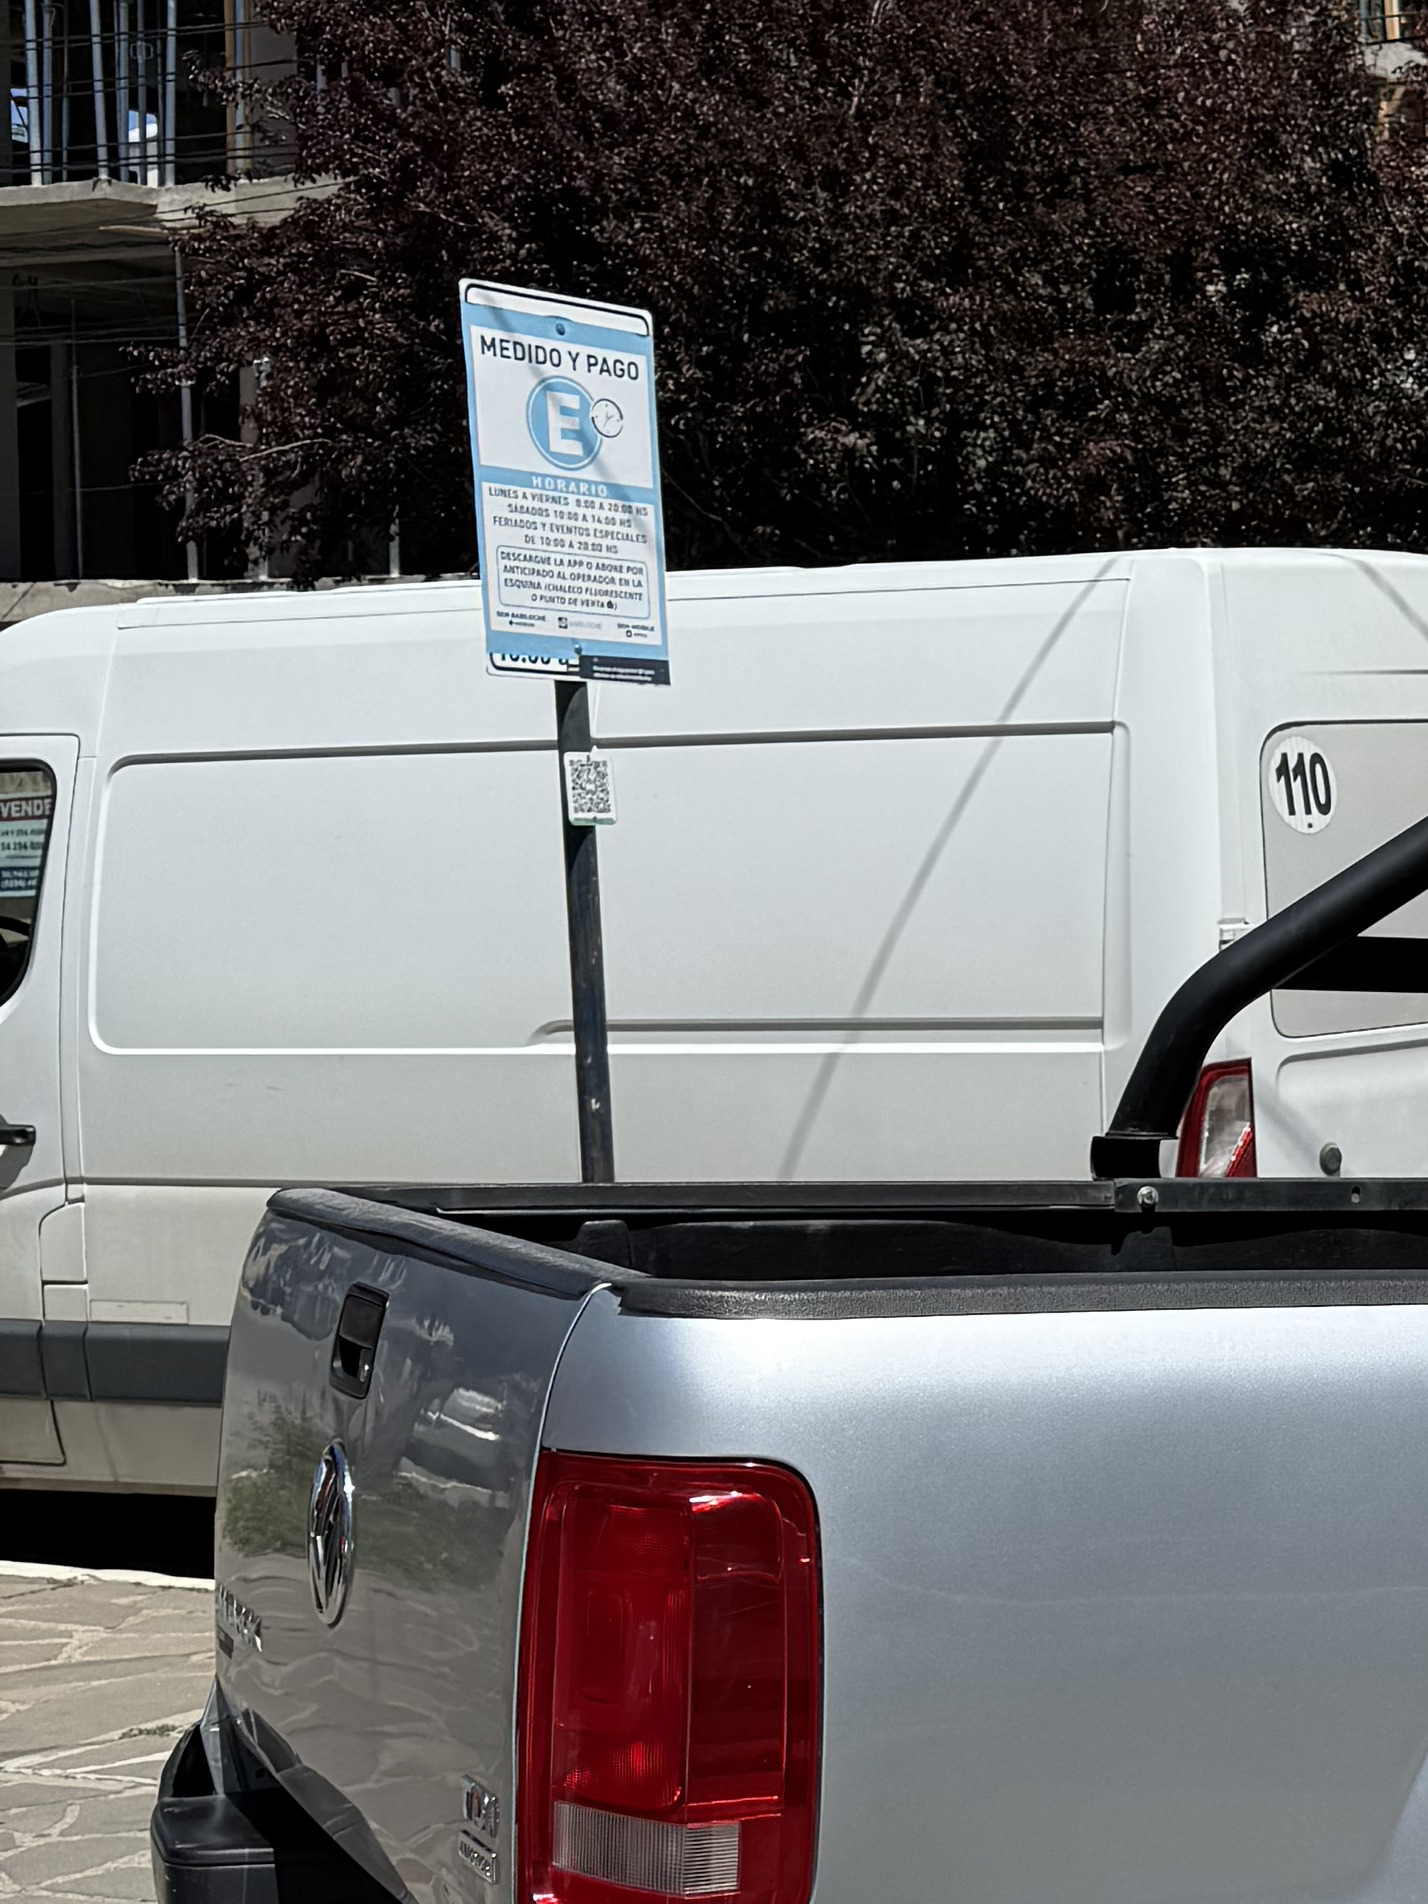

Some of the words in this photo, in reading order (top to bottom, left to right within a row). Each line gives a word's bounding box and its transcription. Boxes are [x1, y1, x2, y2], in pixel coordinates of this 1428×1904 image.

[480, 335, 562, 368] MEDIDO
[568, 350, 580, 371] Y
[587, 354, 639, 381] PAGO
[546, 390, 583, 457] E
[488, 486, 519, 499] LUNES
[522, 491, 528, 500] A
[530, 492, 570, 506] VIERNES
[598, 502, 605, 511] A
[531, 476, 608, 497] HORARIO
[493, 515, 538, 531] FERIADOS
[540, 522, 547, 531] Y
[550, 523, 591, 537] EVENTOS
[593, 528, 648, 544] ESPECIALES
[581, 514, 588, 523] A
[524, 534, 535, 545] DE
[568, 541, 575, 550] A
[554, 558, 565, 567] LA
[503, 564, 554, 579] ANTICIPADO
[556, 571, 568, 581] AL
[570, 572, 617, 585] OPERADOR
[632, 578, 643, 588] LA
[1275, 752, 1331, 816] 110
